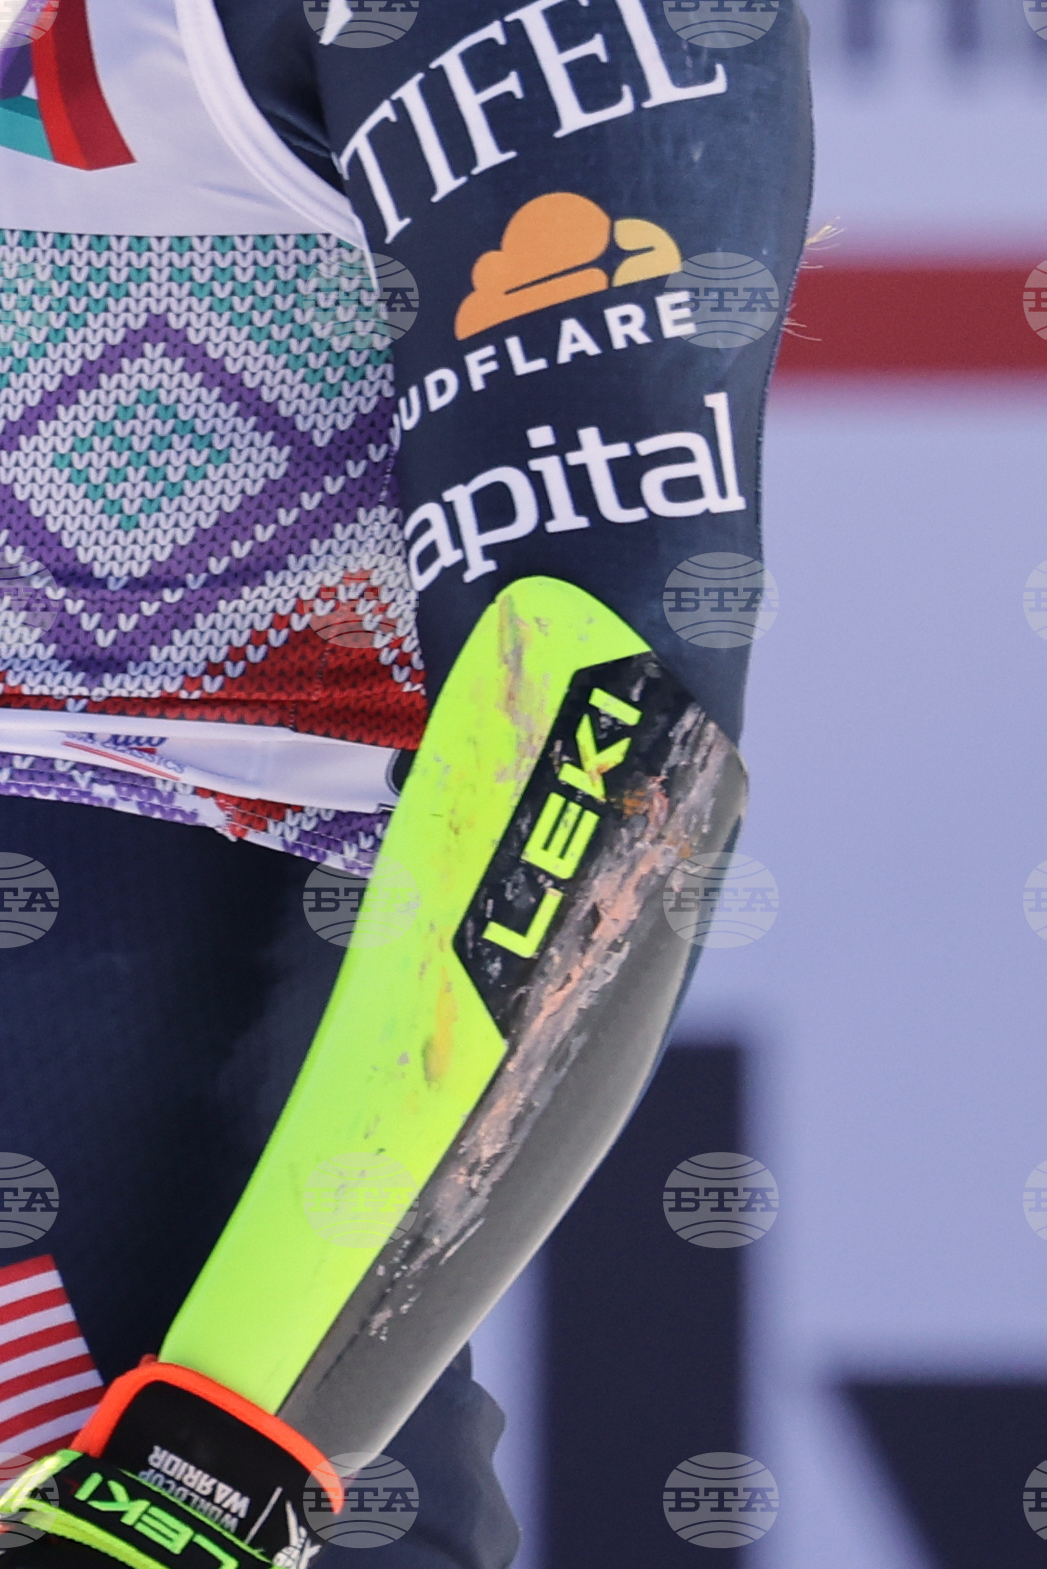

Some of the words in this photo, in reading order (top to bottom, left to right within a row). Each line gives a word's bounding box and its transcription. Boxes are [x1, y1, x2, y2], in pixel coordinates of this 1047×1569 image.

[392, 290, 698, 450] UDFLARE
[481, 687, 643, 959] LEKI
[73, 1472, 240, 1569] LEKI
